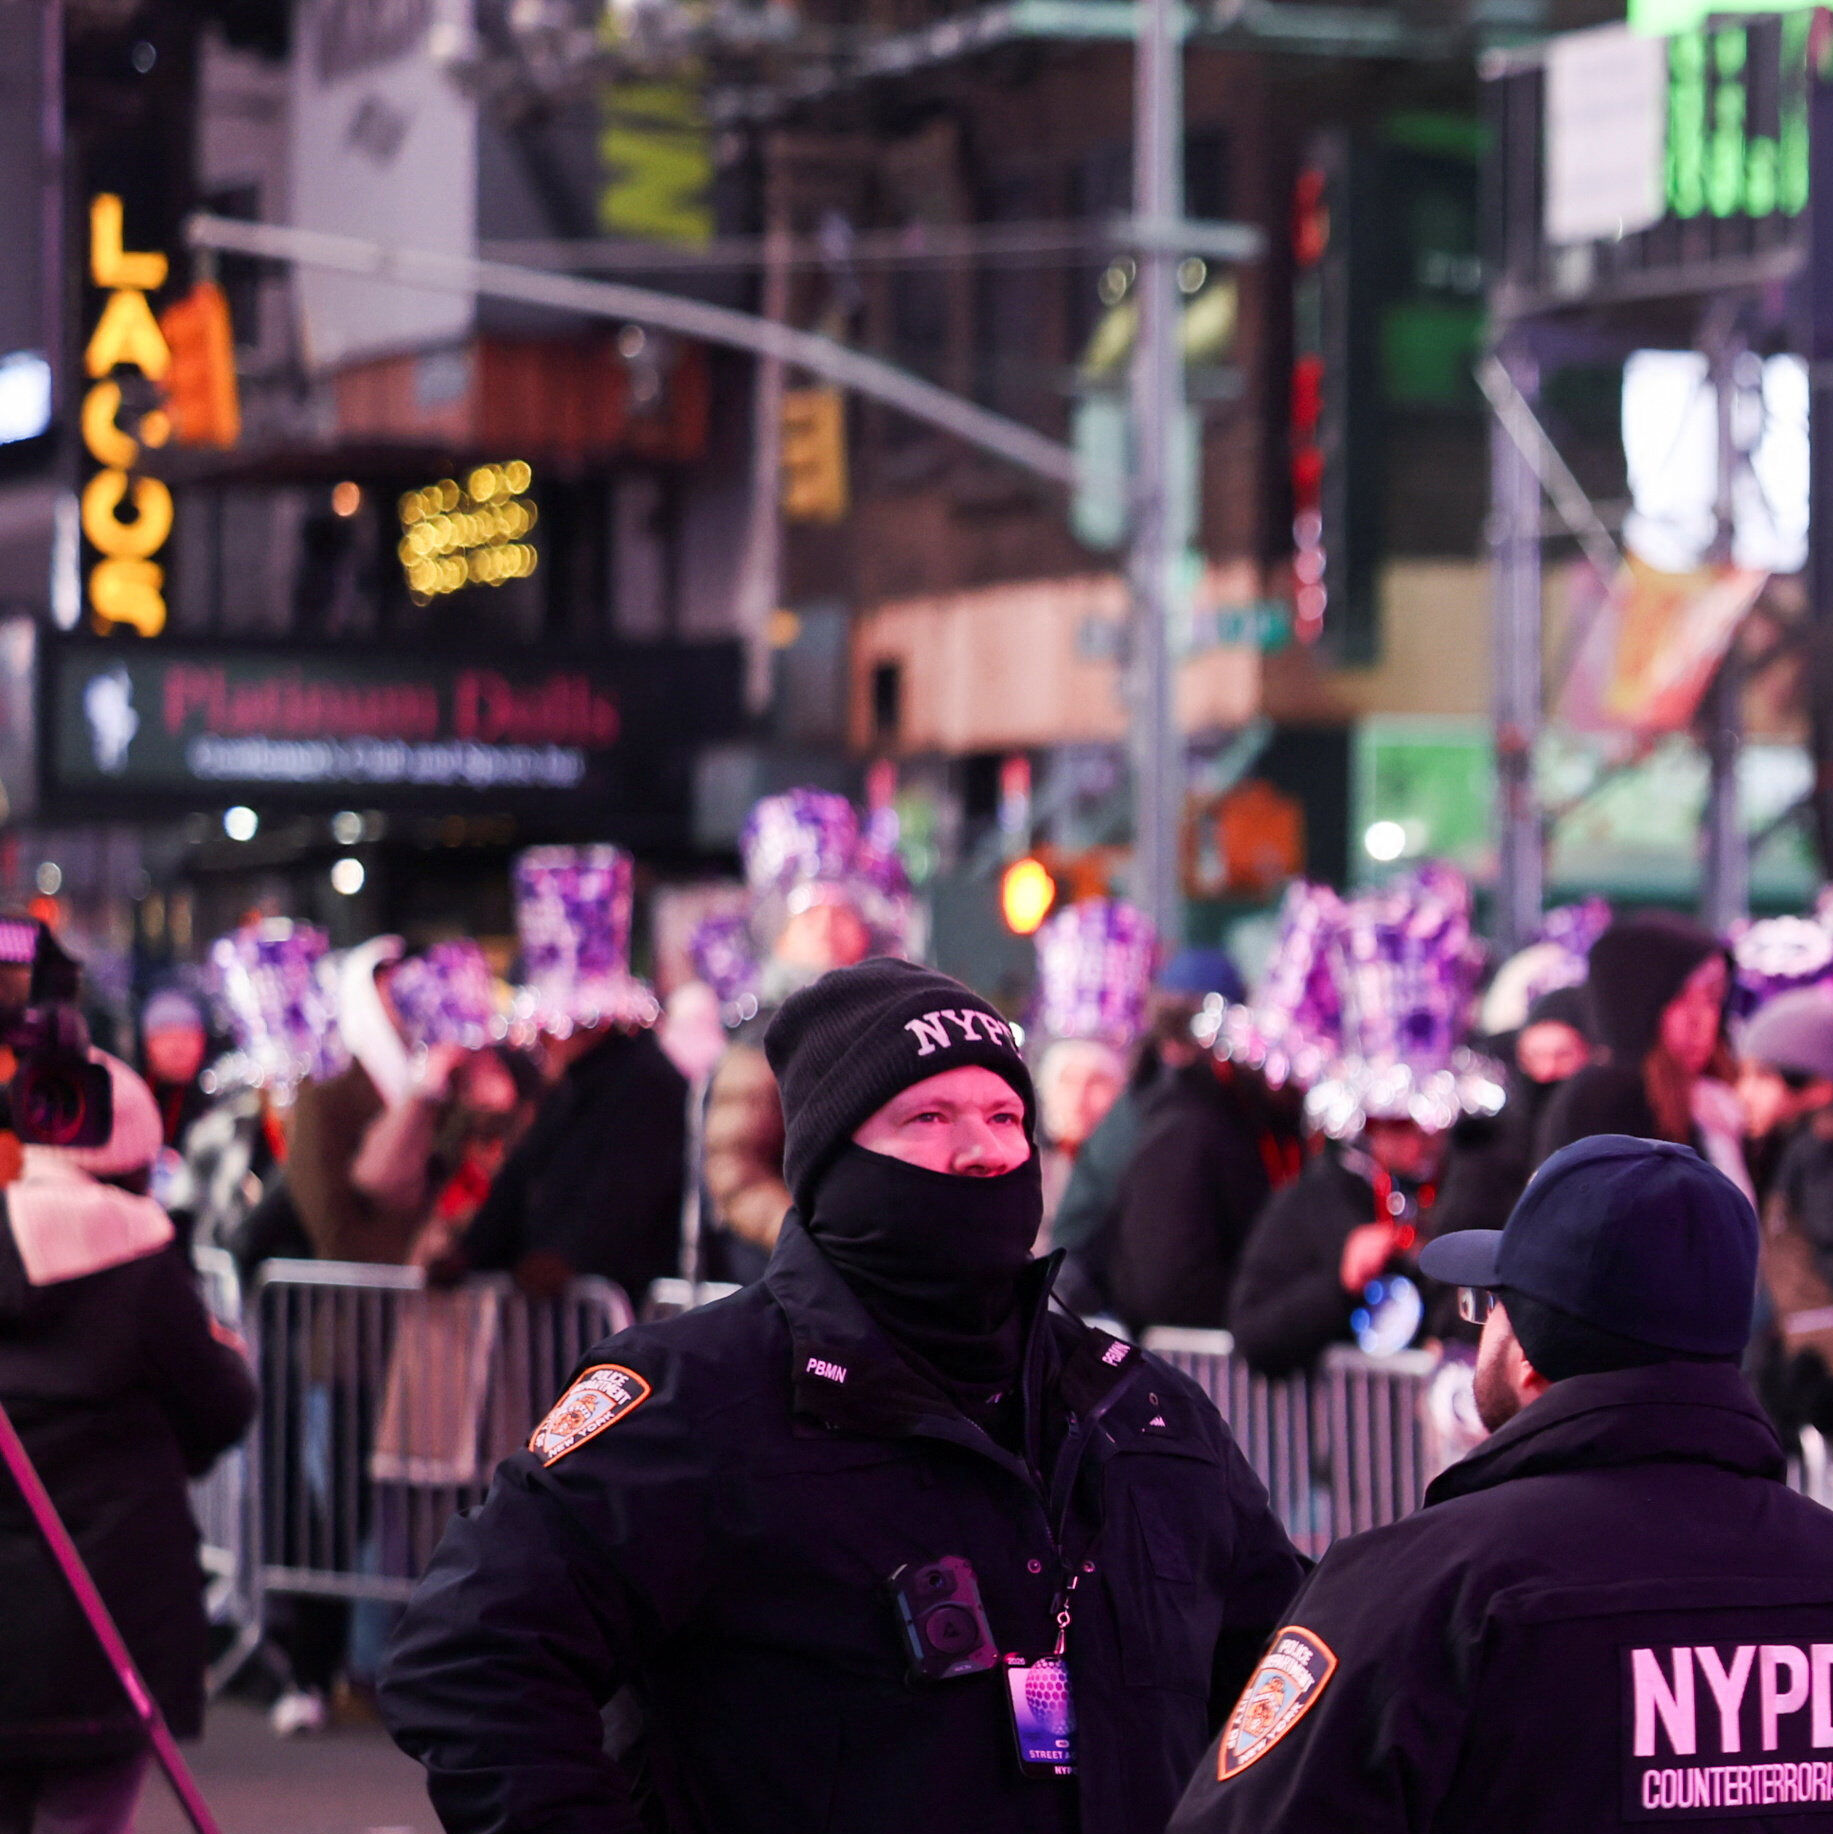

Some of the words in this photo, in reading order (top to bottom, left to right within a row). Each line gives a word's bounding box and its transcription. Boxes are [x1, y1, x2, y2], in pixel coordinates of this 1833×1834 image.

[806, 1357, 848, 1384] PBMN
[548, 1436, 575, 1459] NEW
[578, 1411, 616, 1437] YORK
[1029, 1749, 1064, 1760] STREET
[1054, 1765, 1077, 1775] NYP
